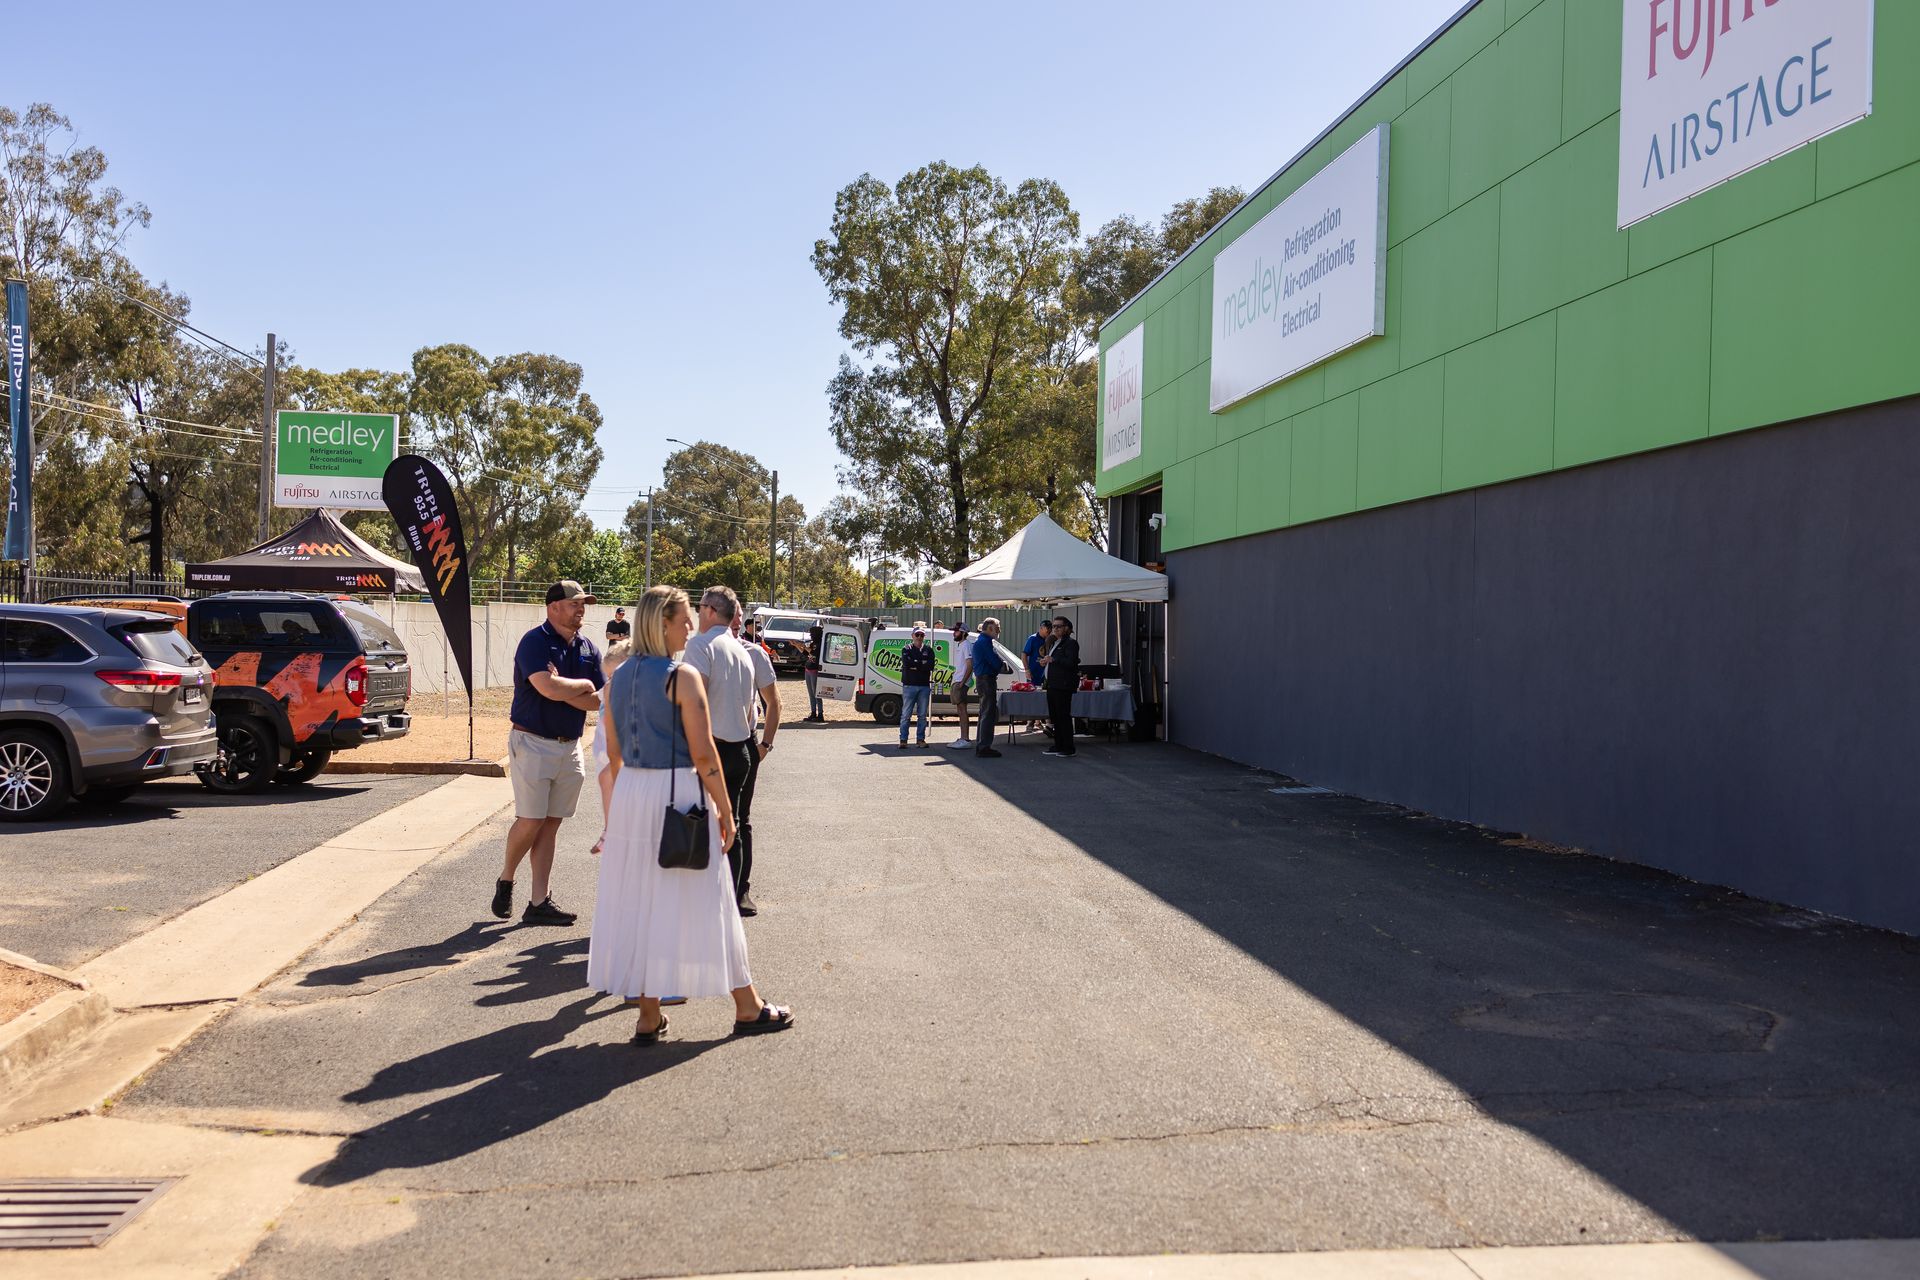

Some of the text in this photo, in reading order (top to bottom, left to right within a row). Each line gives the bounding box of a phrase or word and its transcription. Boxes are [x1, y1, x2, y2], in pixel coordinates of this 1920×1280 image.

[1643, 36, 1833, 189] AIRSTAGE
[1284, 207, 1341, 263] Refrigeration
[1283, 238, 1356, 301] Air-conditioning
[1223, 256, 1284, 340] medley
[1282, 292, 1321, 338] Electrical
[1108, 364, 1137, 422] FUJITSU
[287, 420, 385, 452] medley
[309, 447, 353, 456] Refrigeration
[1107, 423, 1137, 457] AIRSTAGE
[309, 455, 363, 464] Air-conditioning
[309, 463, 340, 471] Electrical
[284, 487, 320, 499] FUJITSU
[413, 495, 430, 521] 93.5
[414, 465, 443, 527] TRIPLE
[408, 525, 422, 552] DUBBO
